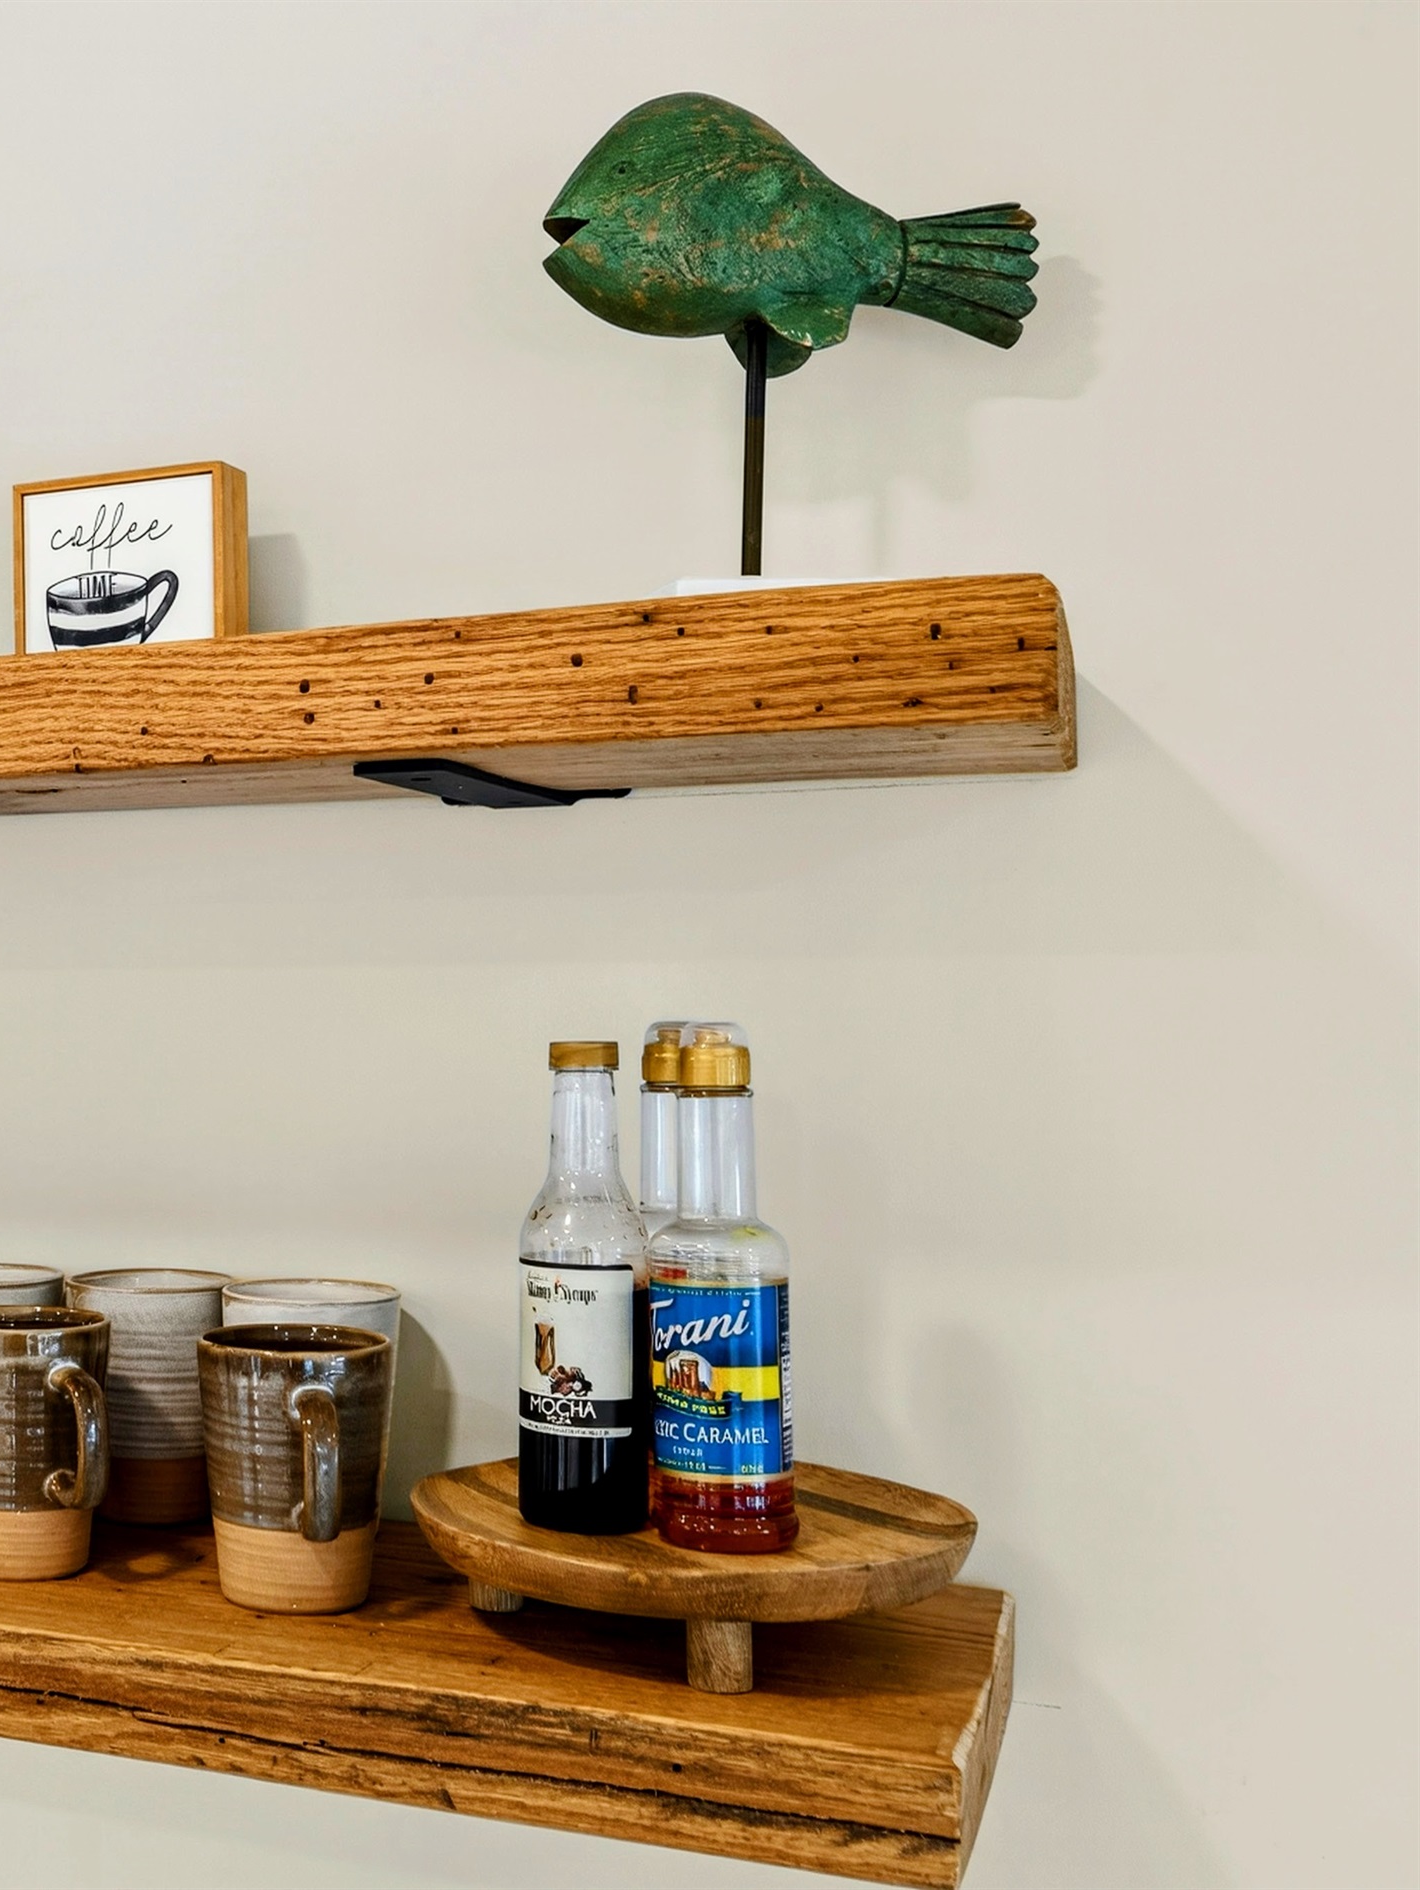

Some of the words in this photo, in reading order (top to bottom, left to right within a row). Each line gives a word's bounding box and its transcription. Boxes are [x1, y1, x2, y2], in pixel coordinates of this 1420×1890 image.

[50, 501, 173, 551] coffee
[75, 574, 116, 599] TIME
[650, 1298, 750, 1351] Torani
[530, 1394, 597, 1419] MOCHA
[683, 1422, 770, 1444] CARAMEL
